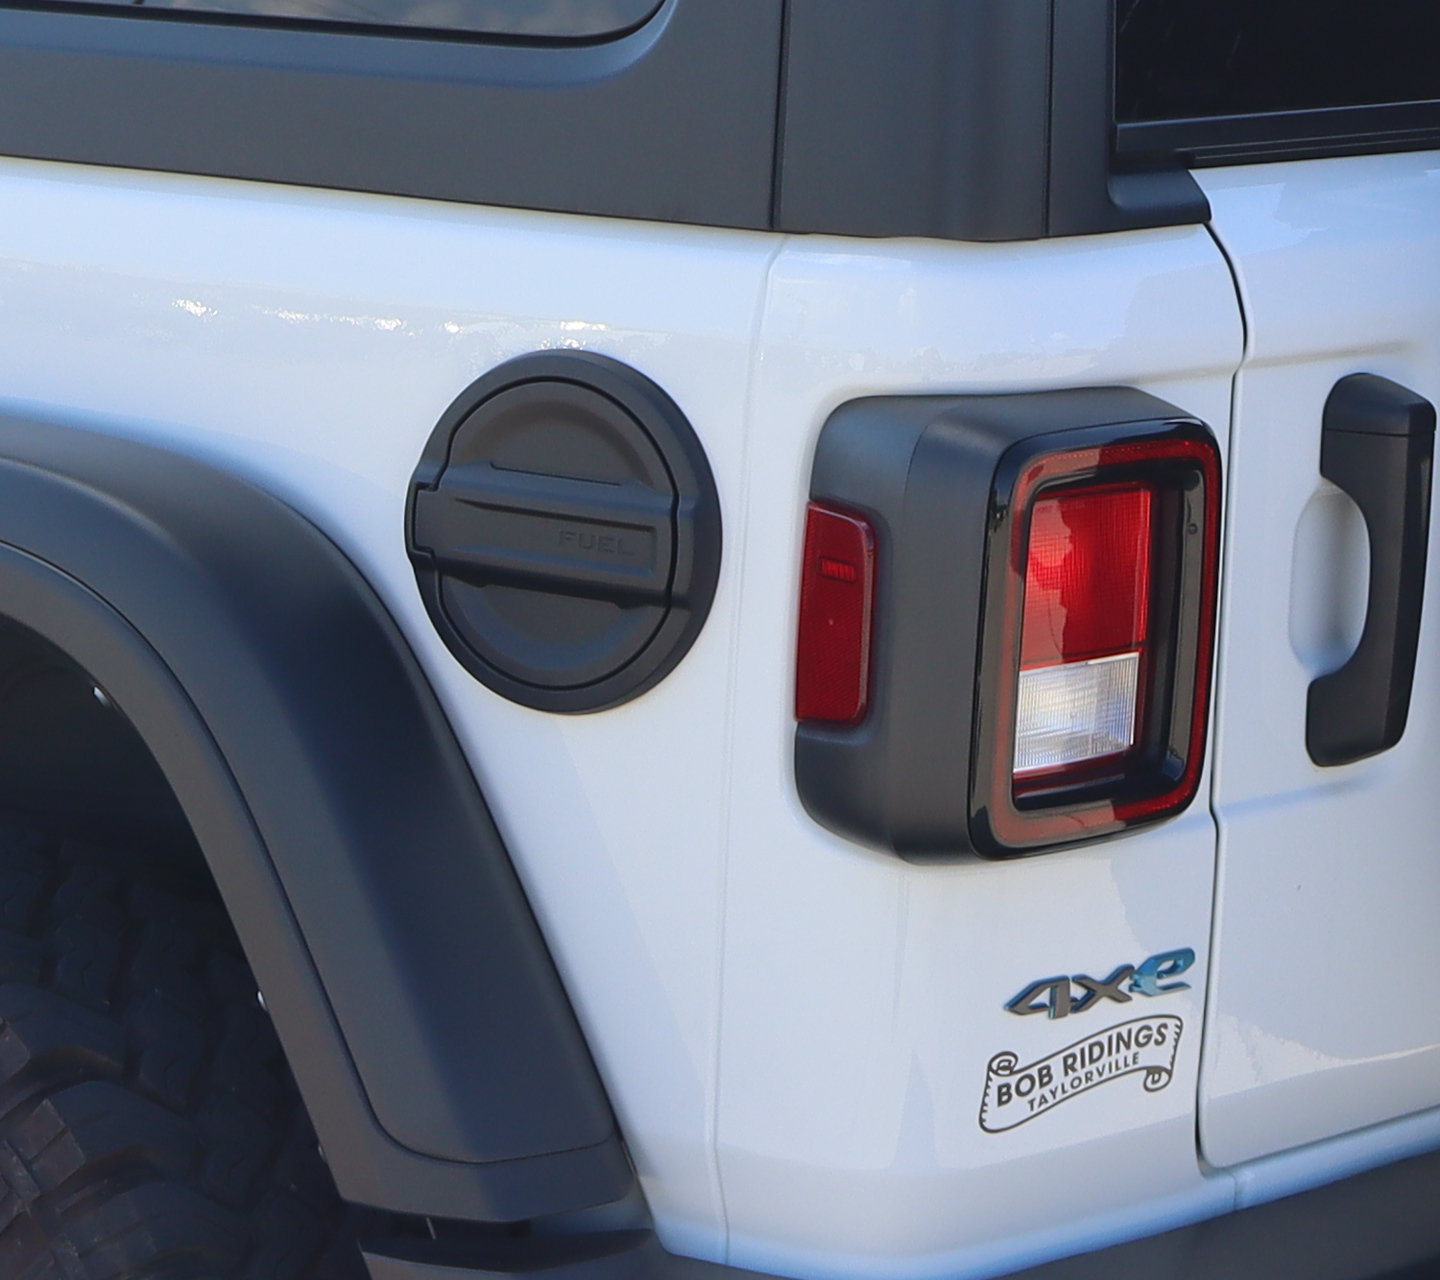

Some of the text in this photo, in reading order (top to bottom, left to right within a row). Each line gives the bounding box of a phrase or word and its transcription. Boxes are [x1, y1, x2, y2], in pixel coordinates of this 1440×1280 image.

[558, 529, 636, 557] FUEL
[997, 1022, 1169, 1108] BOB RIDINGS
[1027, 1051, 1140, 1112] TAYLORVILLE
